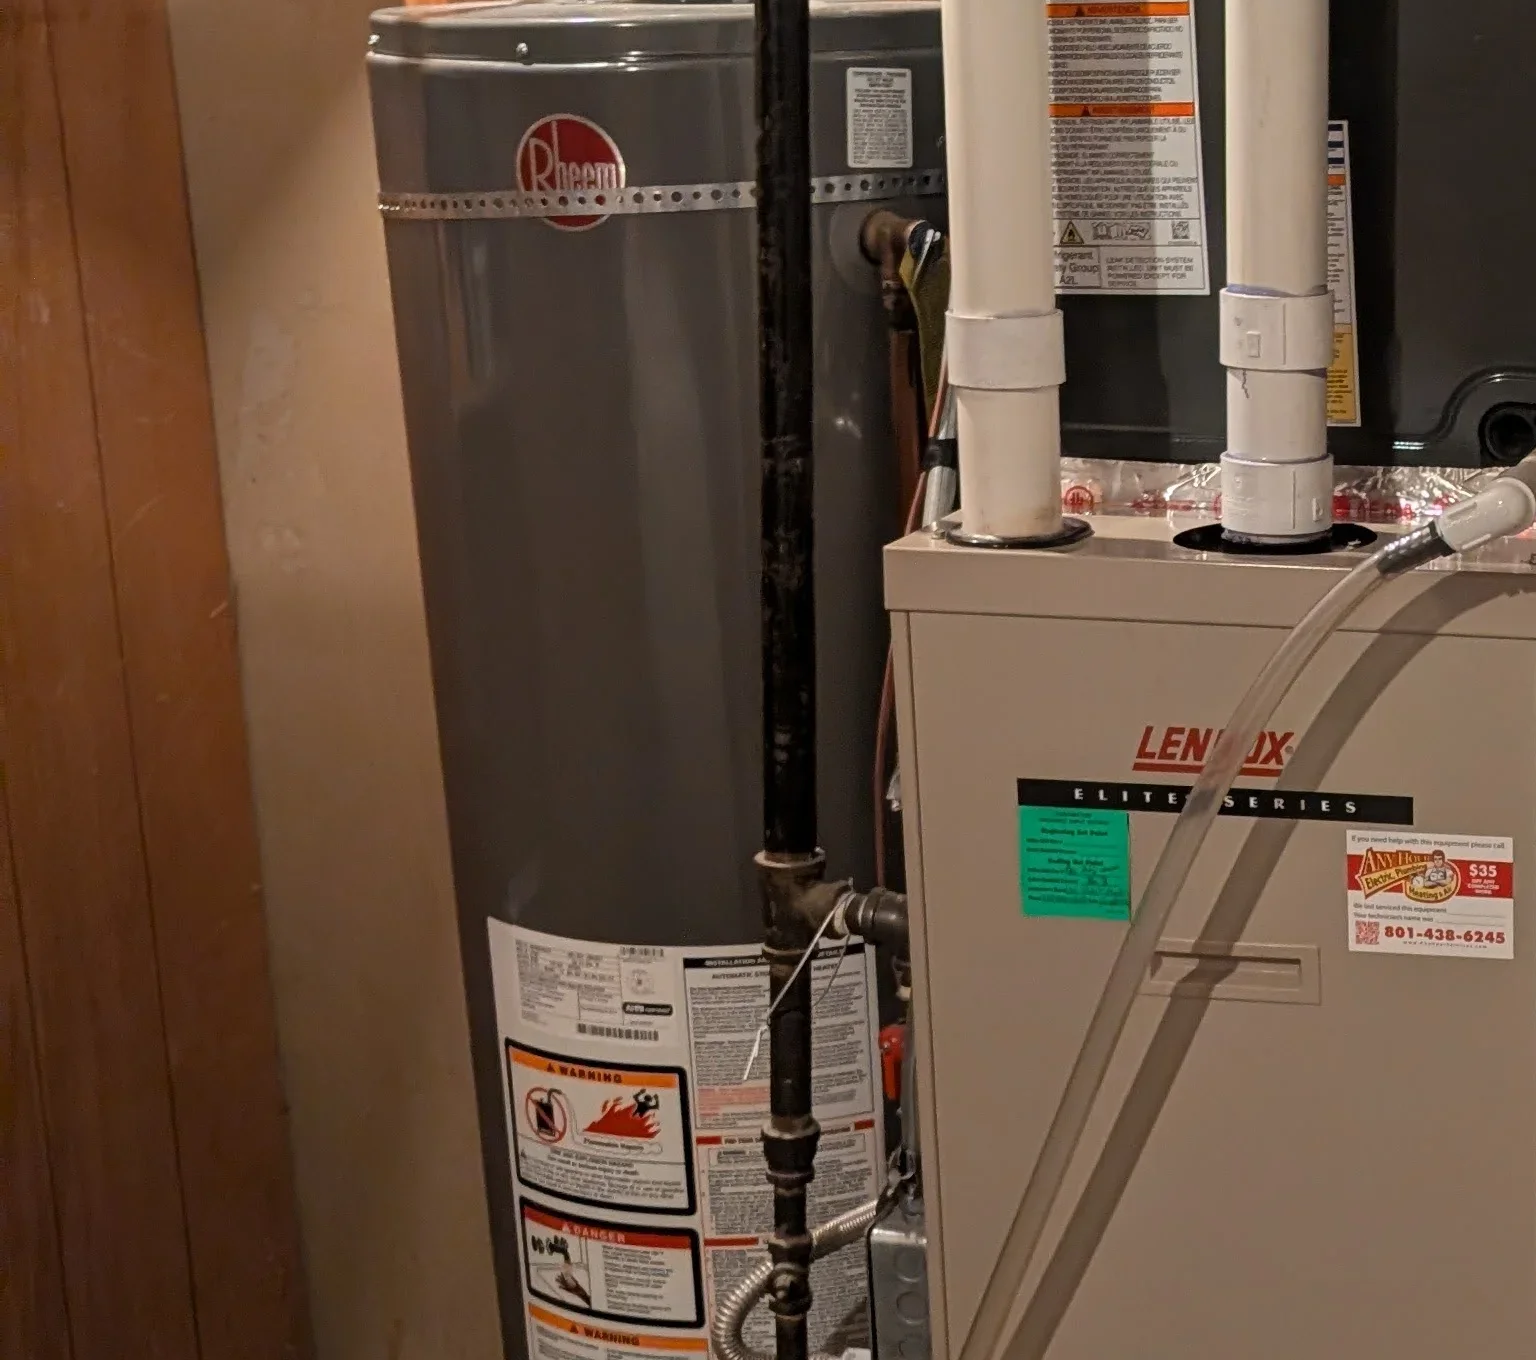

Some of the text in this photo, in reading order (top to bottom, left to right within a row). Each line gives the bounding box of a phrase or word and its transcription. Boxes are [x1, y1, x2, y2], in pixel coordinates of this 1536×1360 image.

[528, 120, 617, 190] Rheem
[1068, 262, 1100, 275] Group
[1060, 275, 1079, 285] A2L
[1136, 724, 1294, 766] LENX
[1073, 787, 1358, 814] ELITE SERIES
[1357, 836, 1370, 844] you
[1388, 836, 1403, 845] help
[1469, 863, 1498, 878] $35
[1384, 925, 1506, 945] 801-438-6245
[559, 1065, 623, 1084] WARNING
[573, 1225, 626, 1243] DANGER
[584, 1326, 641, 1346] WARNING
